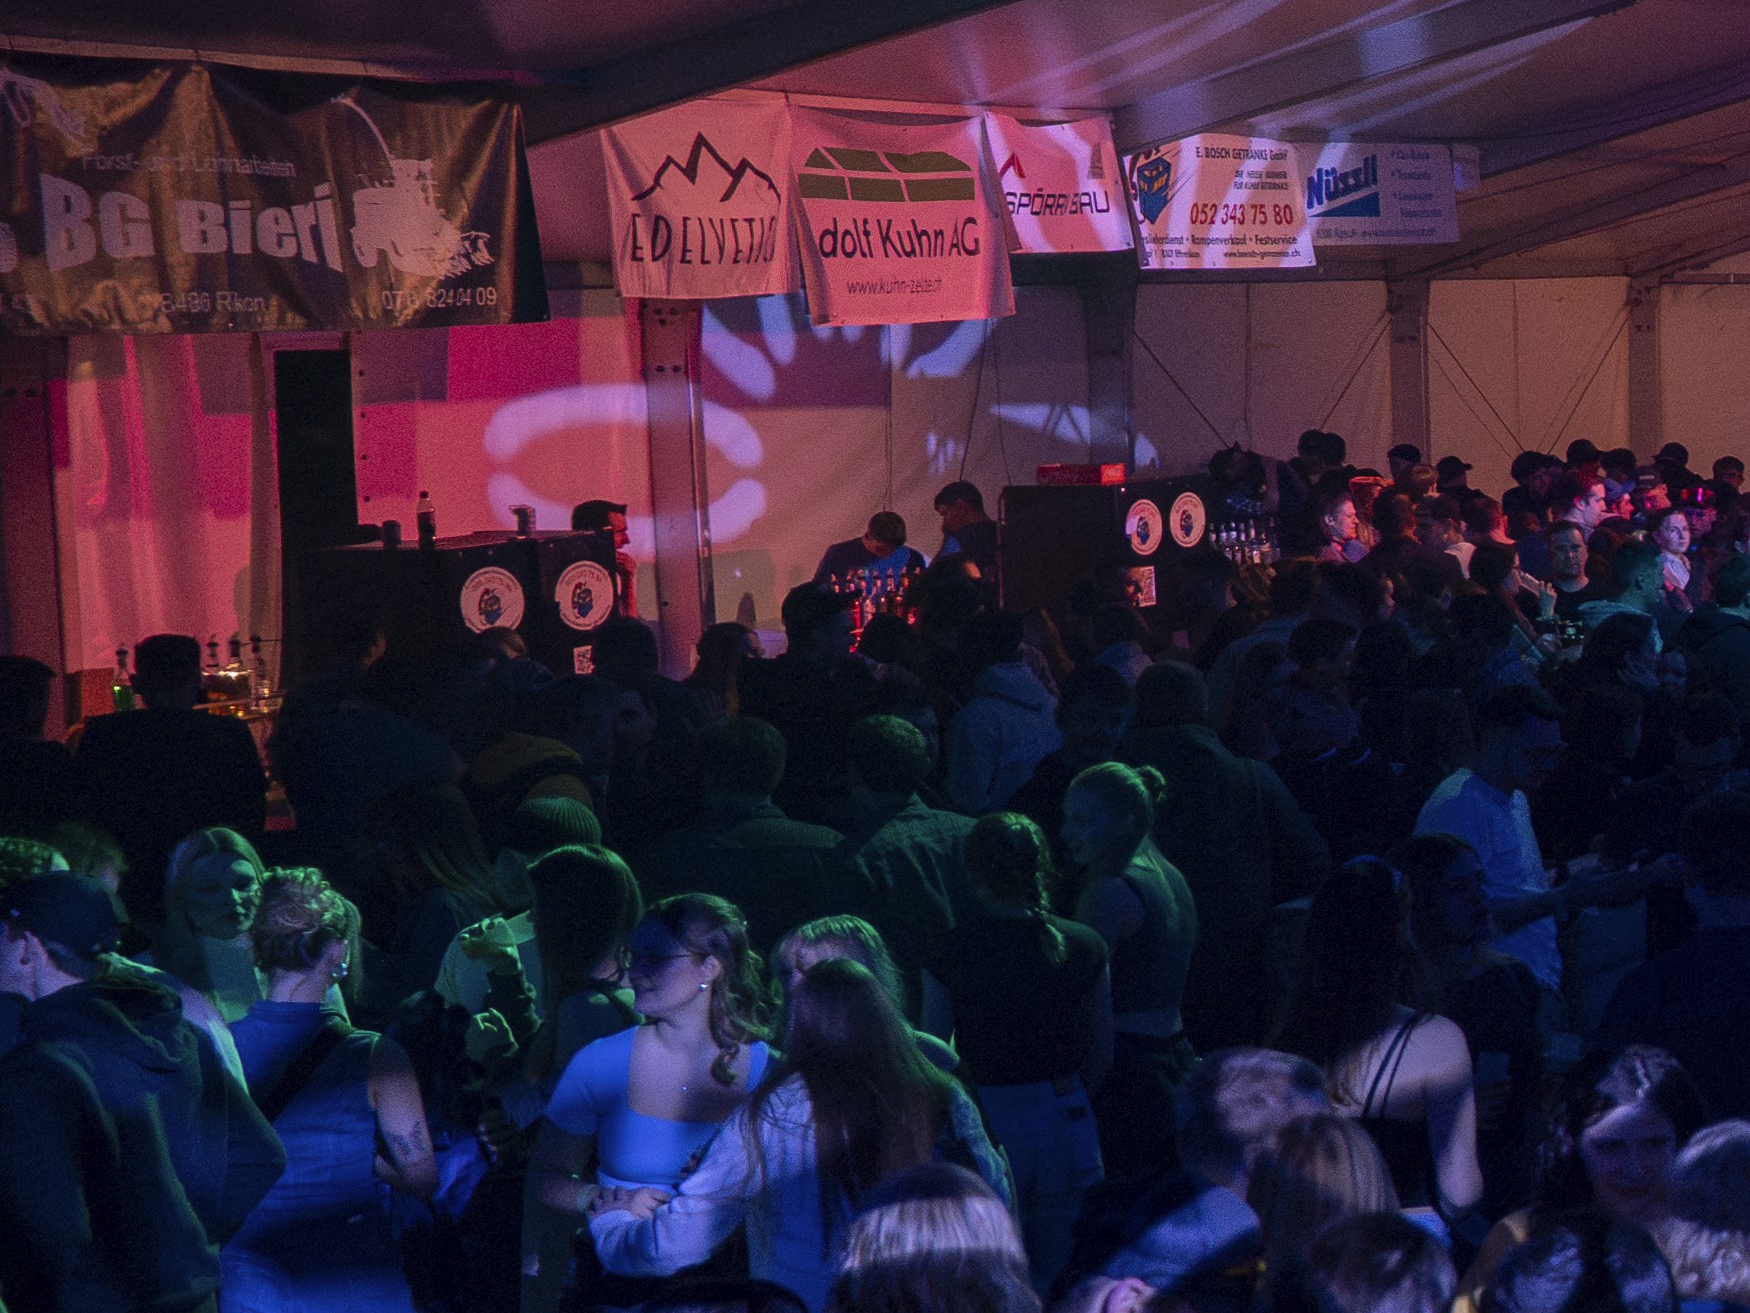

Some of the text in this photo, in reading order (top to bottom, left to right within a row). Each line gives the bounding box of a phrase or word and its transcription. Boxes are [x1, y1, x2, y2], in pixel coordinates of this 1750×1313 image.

[39, 173, 344, 273] BG Bieri
[1190, 202, 1294, 226] 052 343 75 80
[818, 216, 982, 260] dolf Kuhn AG
